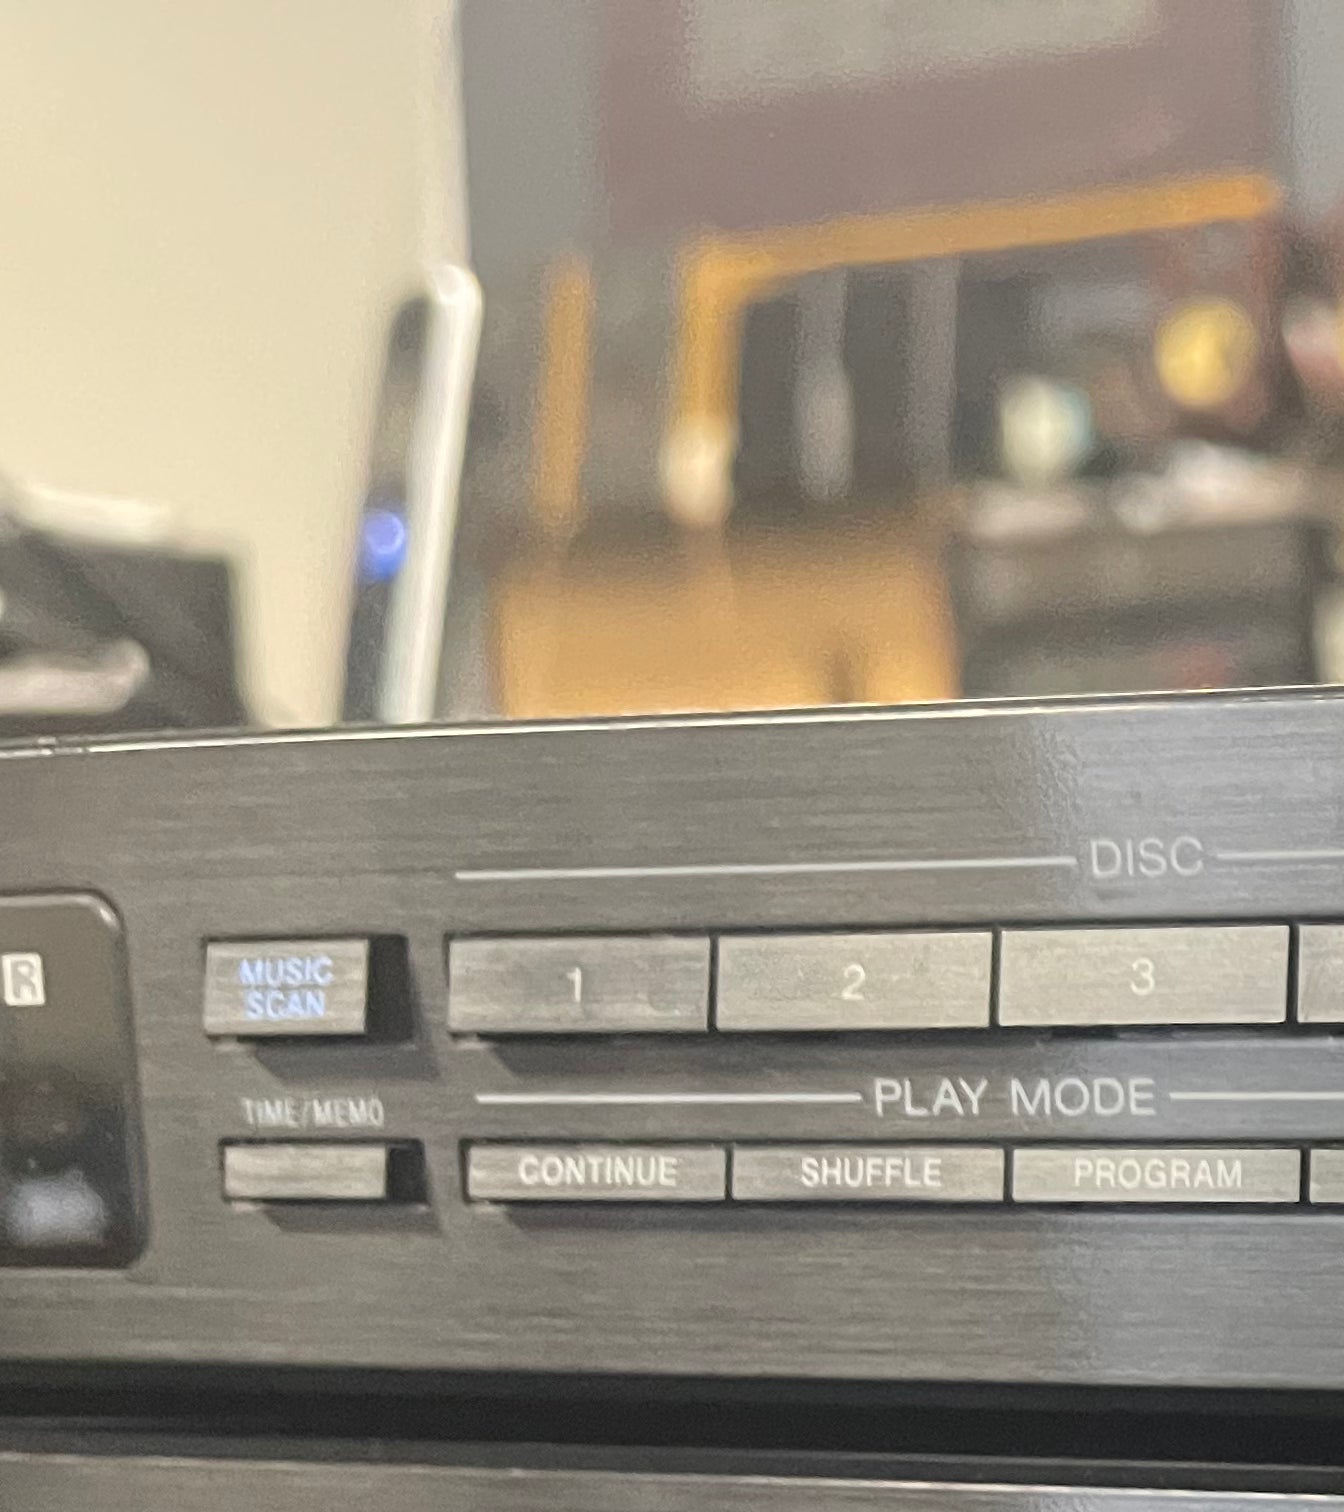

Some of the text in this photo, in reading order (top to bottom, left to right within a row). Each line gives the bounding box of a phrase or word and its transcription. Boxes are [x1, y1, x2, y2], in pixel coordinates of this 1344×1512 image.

[1090, 839, 1202, 878] DISC
[239, 956, 334, 986] MUSIC
[566, 967, 583, 1002] 1
[841, 964, 866, 1002] 2
[1130, 958, 1156, 996] 3
[245, 989, 325, 1019] SCAN
[874, 1078, 1157, 1118] PLAY MODE
[518, 1155, 678, 1186] CONTINUE
[800, 1157, 942, 1190] SHUFFLE
[1074, 1158, 1243, 1190] PROGRAM
